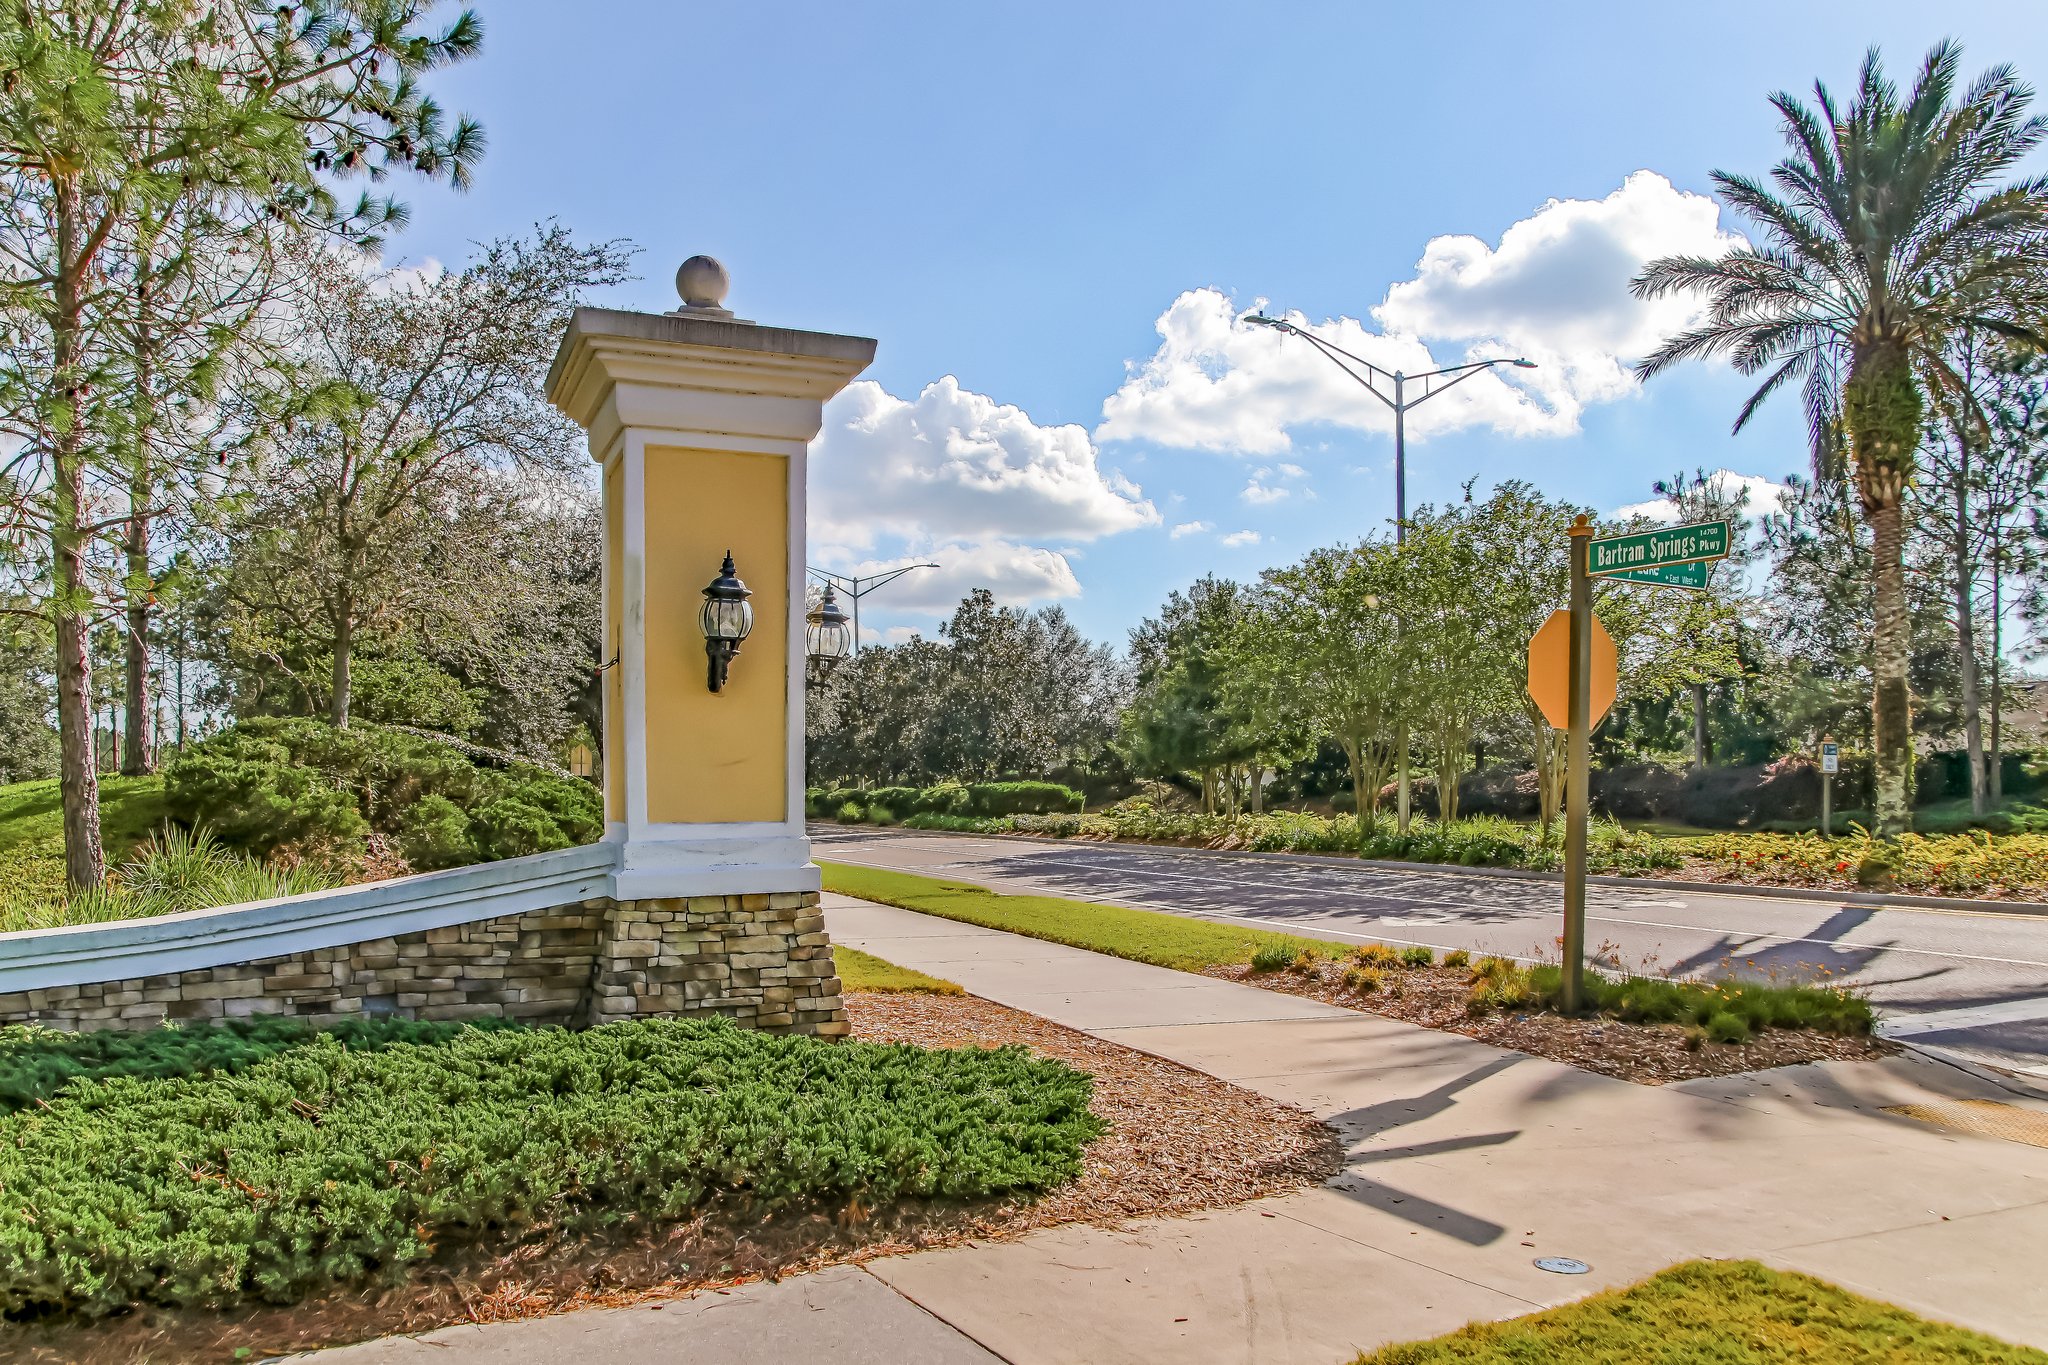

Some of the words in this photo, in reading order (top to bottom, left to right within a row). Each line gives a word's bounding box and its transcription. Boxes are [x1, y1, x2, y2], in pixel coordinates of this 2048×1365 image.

[1700, 528, 1718, 536] 14700
[1598, 543, 1644, 566] Bartram
[1650, 534, 1696, 561] Springs
[1699, 539, 1720, 551] Pkwy
[1669, 574, 1679, 583] East
[1682, 576, 1693, 585] West
